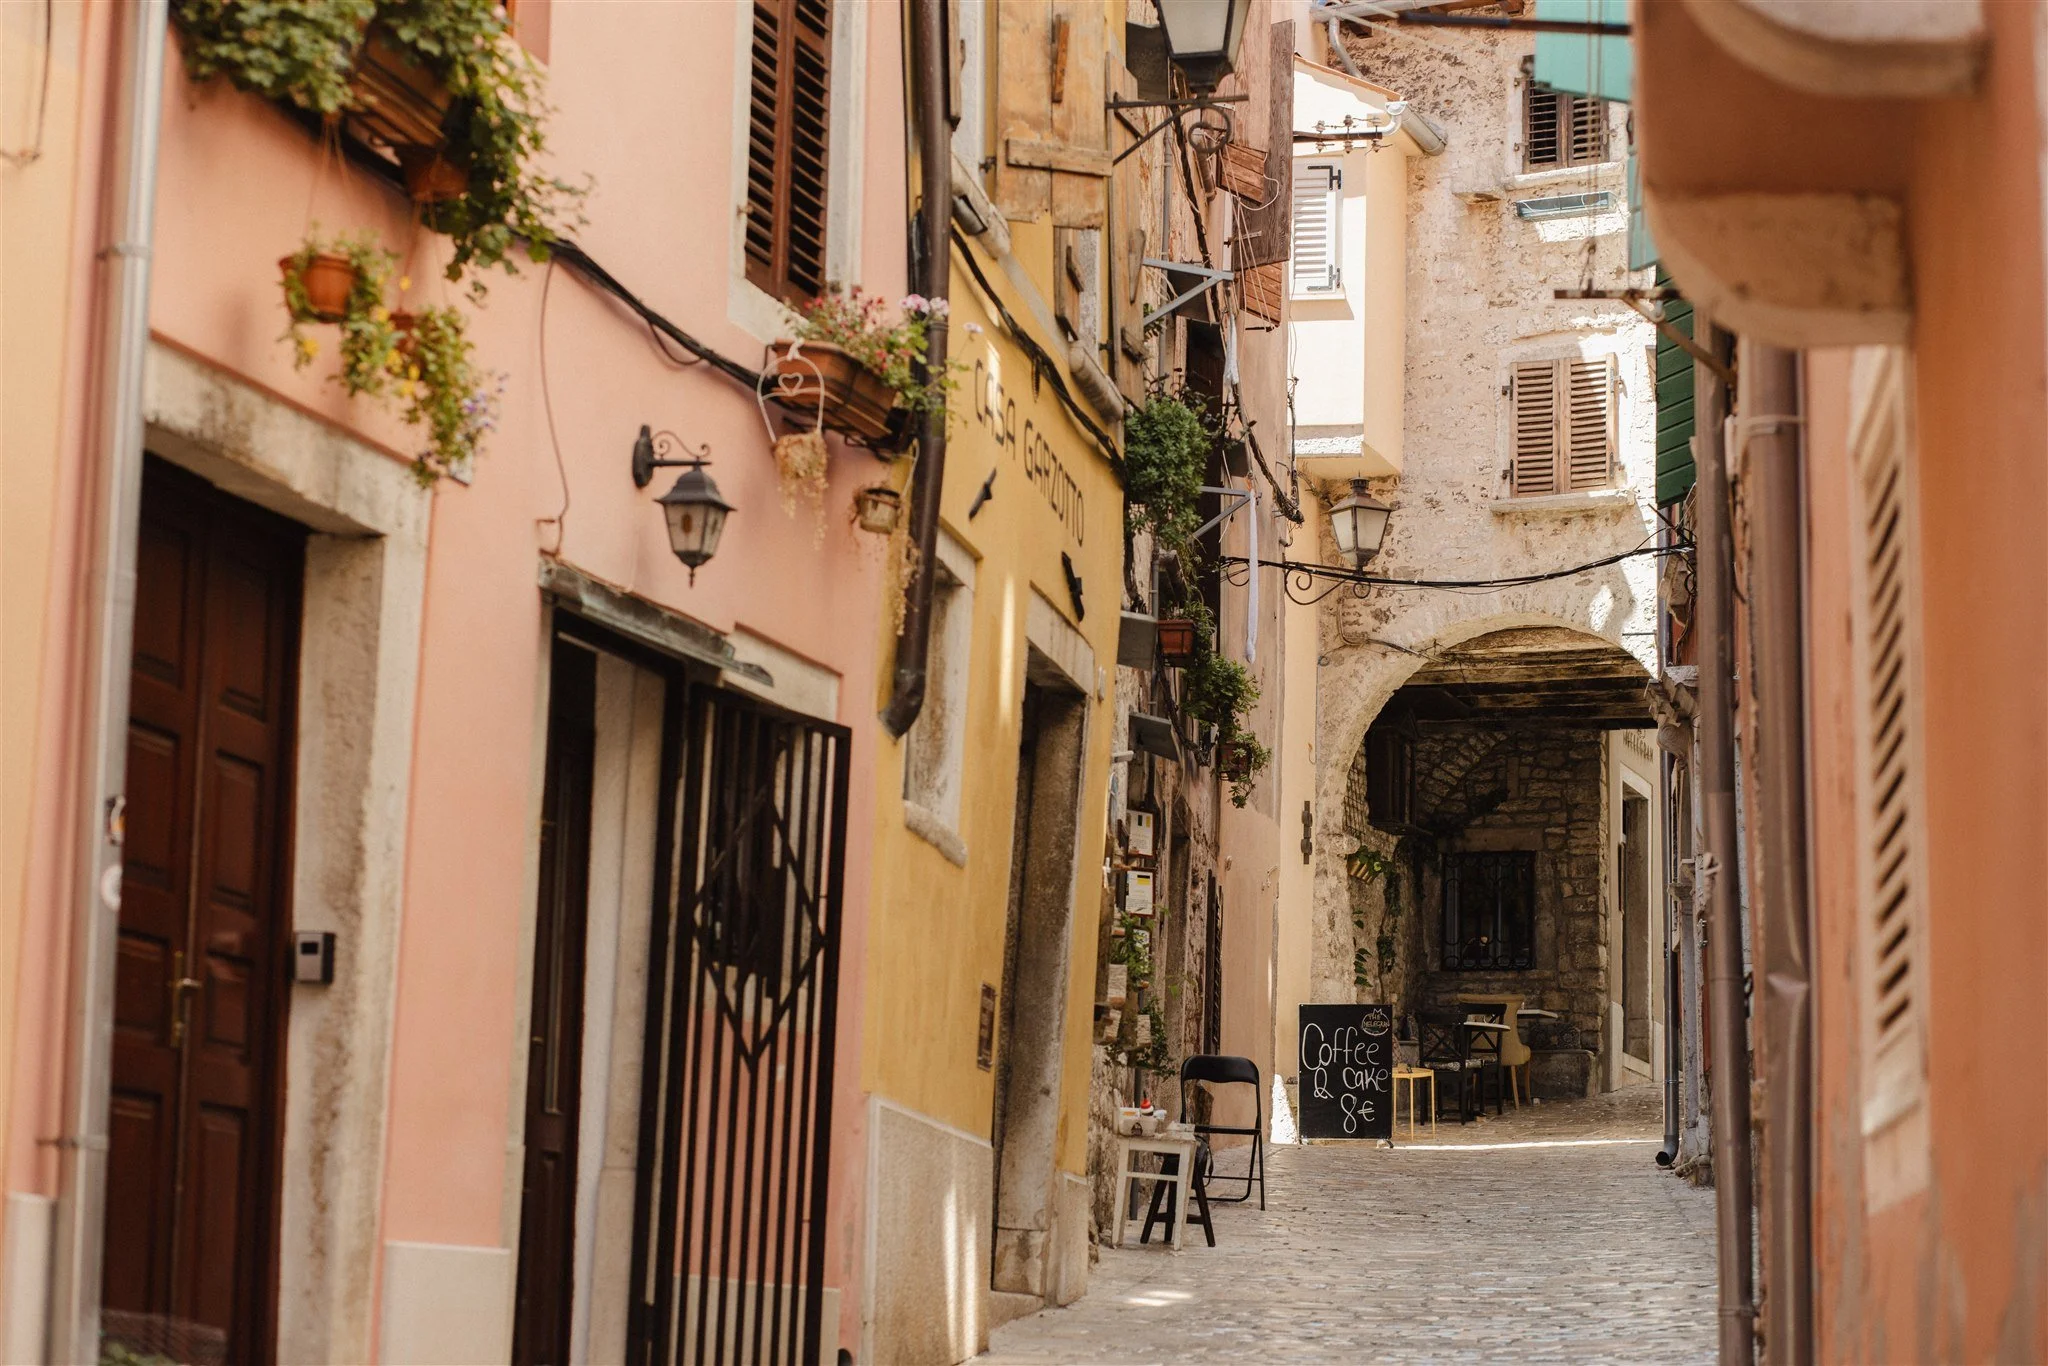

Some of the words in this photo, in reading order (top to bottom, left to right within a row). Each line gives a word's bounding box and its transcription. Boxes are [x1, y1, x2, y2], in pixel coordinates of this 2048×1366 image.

[975, 358, 1016, 460] CASA
[1024, 419, 1084, 547] GARZOTTO
[1303, 1023, 1379, 1070] Coffee
[1313, 1067, 1334, 1099] &
[1340, 1093, 1375, 1133] 8€
